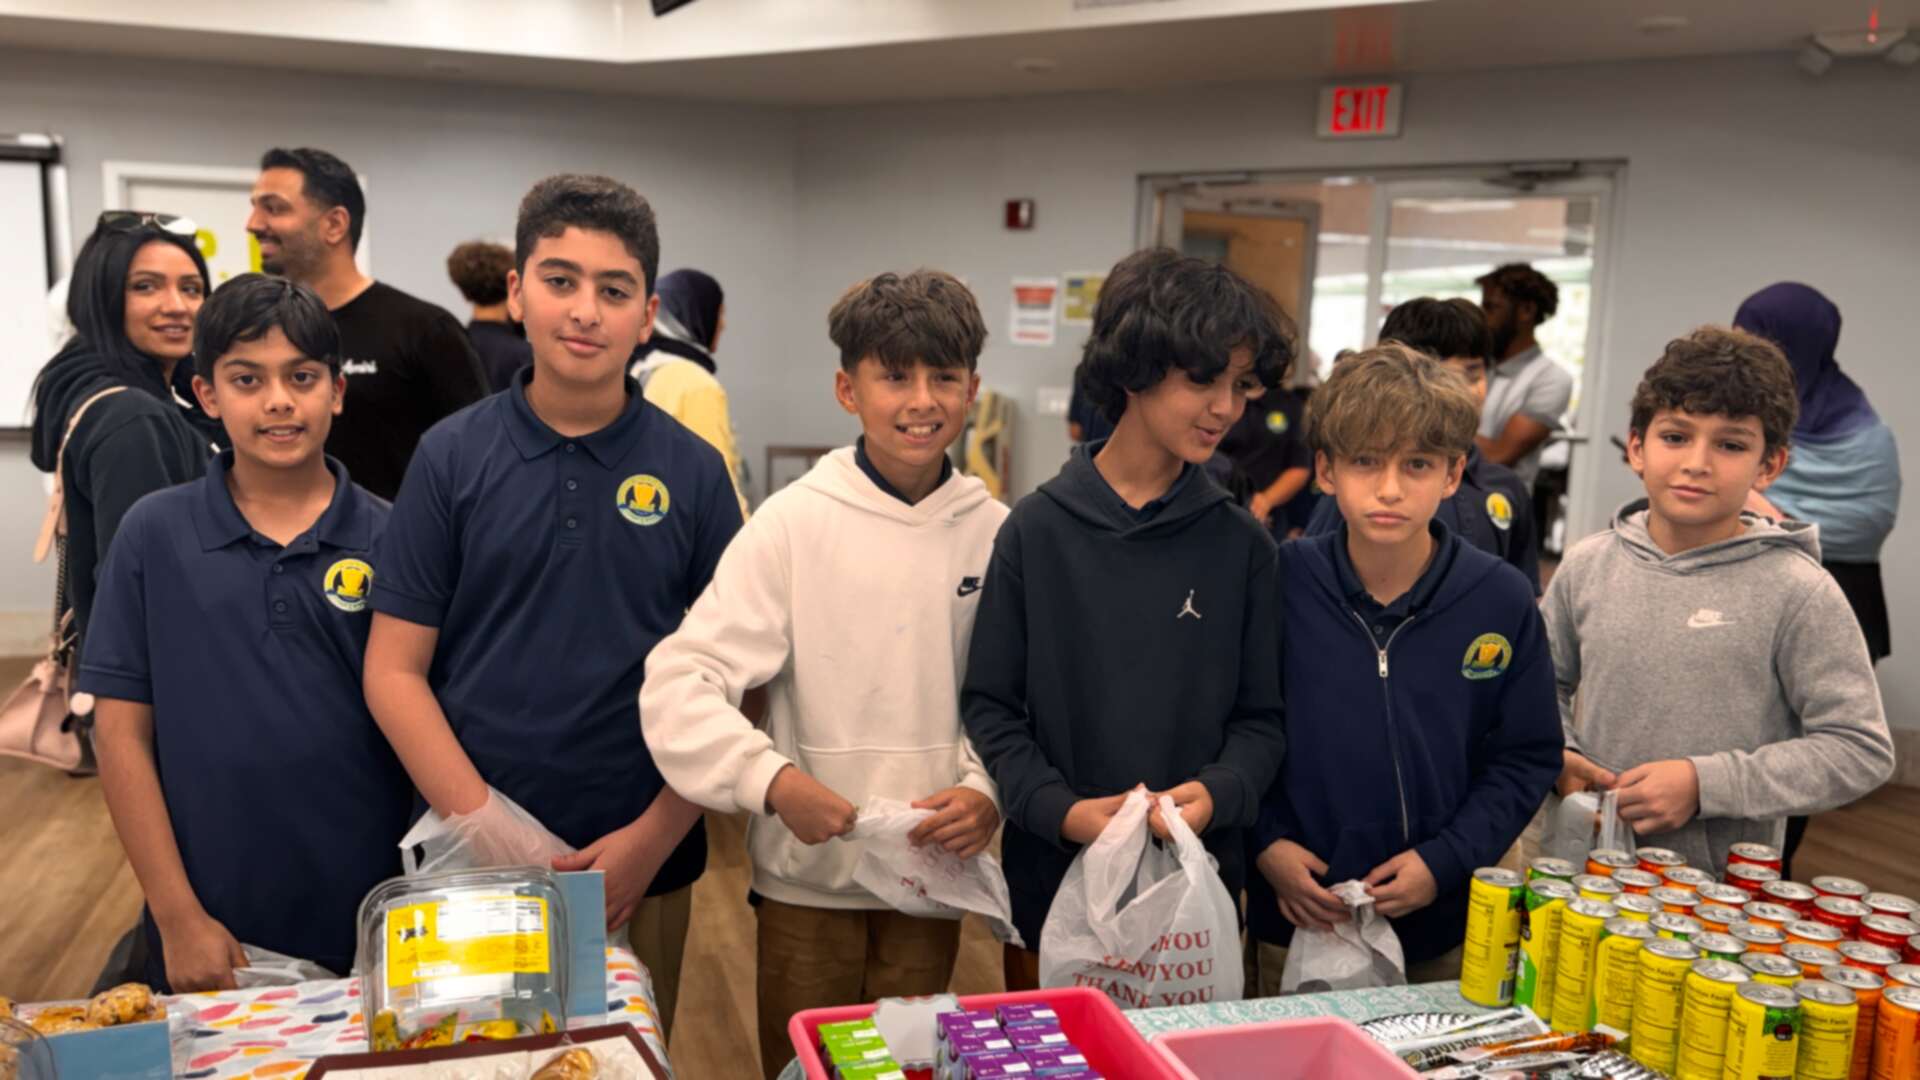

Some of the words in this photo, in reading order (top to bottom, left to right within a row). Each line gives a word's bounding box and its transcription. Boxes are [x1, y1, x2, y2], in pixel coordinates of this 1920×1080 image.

[1331, 85, 1390, 133] EXIT
[1159, 958, 1214, 981] YOU
[1160, 984, 1215, 1007] YOU
